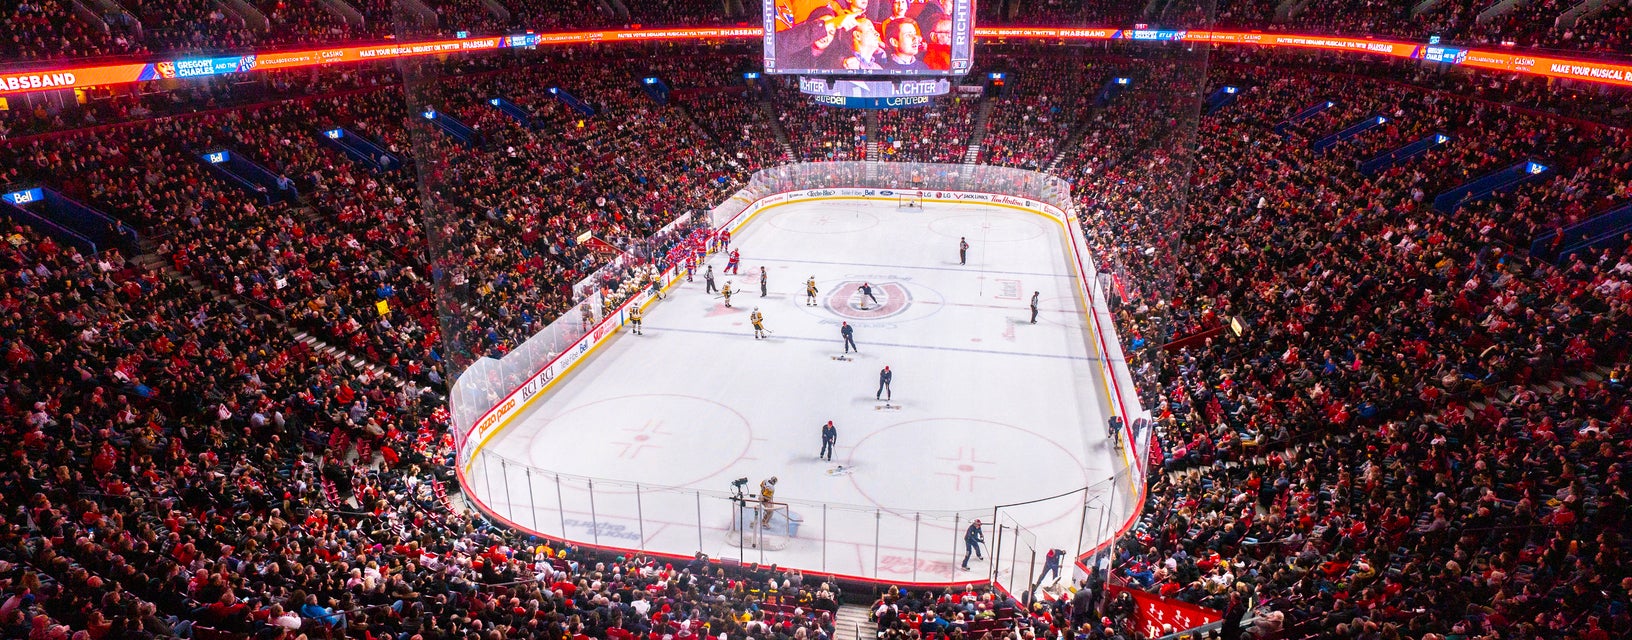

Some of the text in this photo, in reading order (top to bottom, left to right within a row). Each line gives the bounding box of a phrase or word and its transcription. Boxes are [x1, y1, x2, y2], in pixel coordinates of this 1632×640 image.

[360, 49, 376, 57] MAKE
[377, 48, 390, 56] YOUR
[177, 59, 213, 69] GREGORY
[179, 66, 215, 76] CHARLES
[1551, 64, 1570, 74] MAKE
[1570, 66, 1590, 76] YOUR
[1591, 68, 1623, 80] MUSICAL
[210, 152, 223, 163] Bell
[14, 190, 33, 203] Bell
[991, 195, 1001, 203] Tim
[1002, 197, 1023, 206] Hortons
[539, 366, 554, 386] RCI
[521, 380, 537, 400] RCI
[478, 398, 516, 439] pizza pizza
